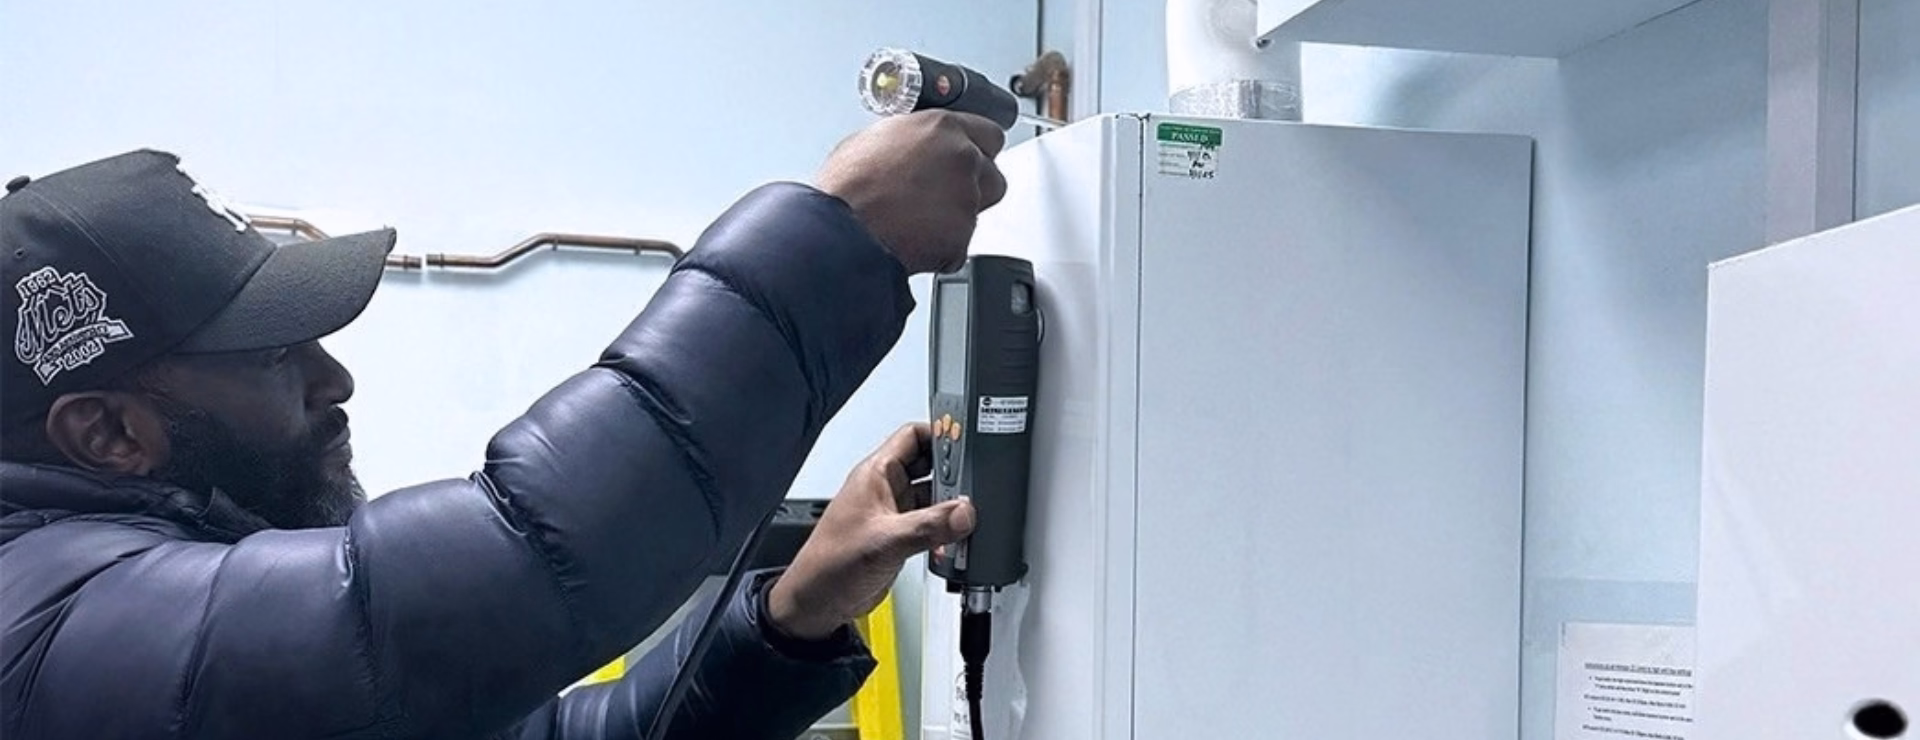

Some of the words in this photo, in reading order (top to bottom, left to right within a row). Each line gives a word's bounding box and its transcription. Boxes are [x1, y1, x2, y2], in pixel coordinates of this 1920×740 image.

[1171, 131, 1209, 143] PASSED
[20, 270, 56, 296] 1962
[19, 278, 100, 360] Mets
[63, 339, 99, 366] 2002
